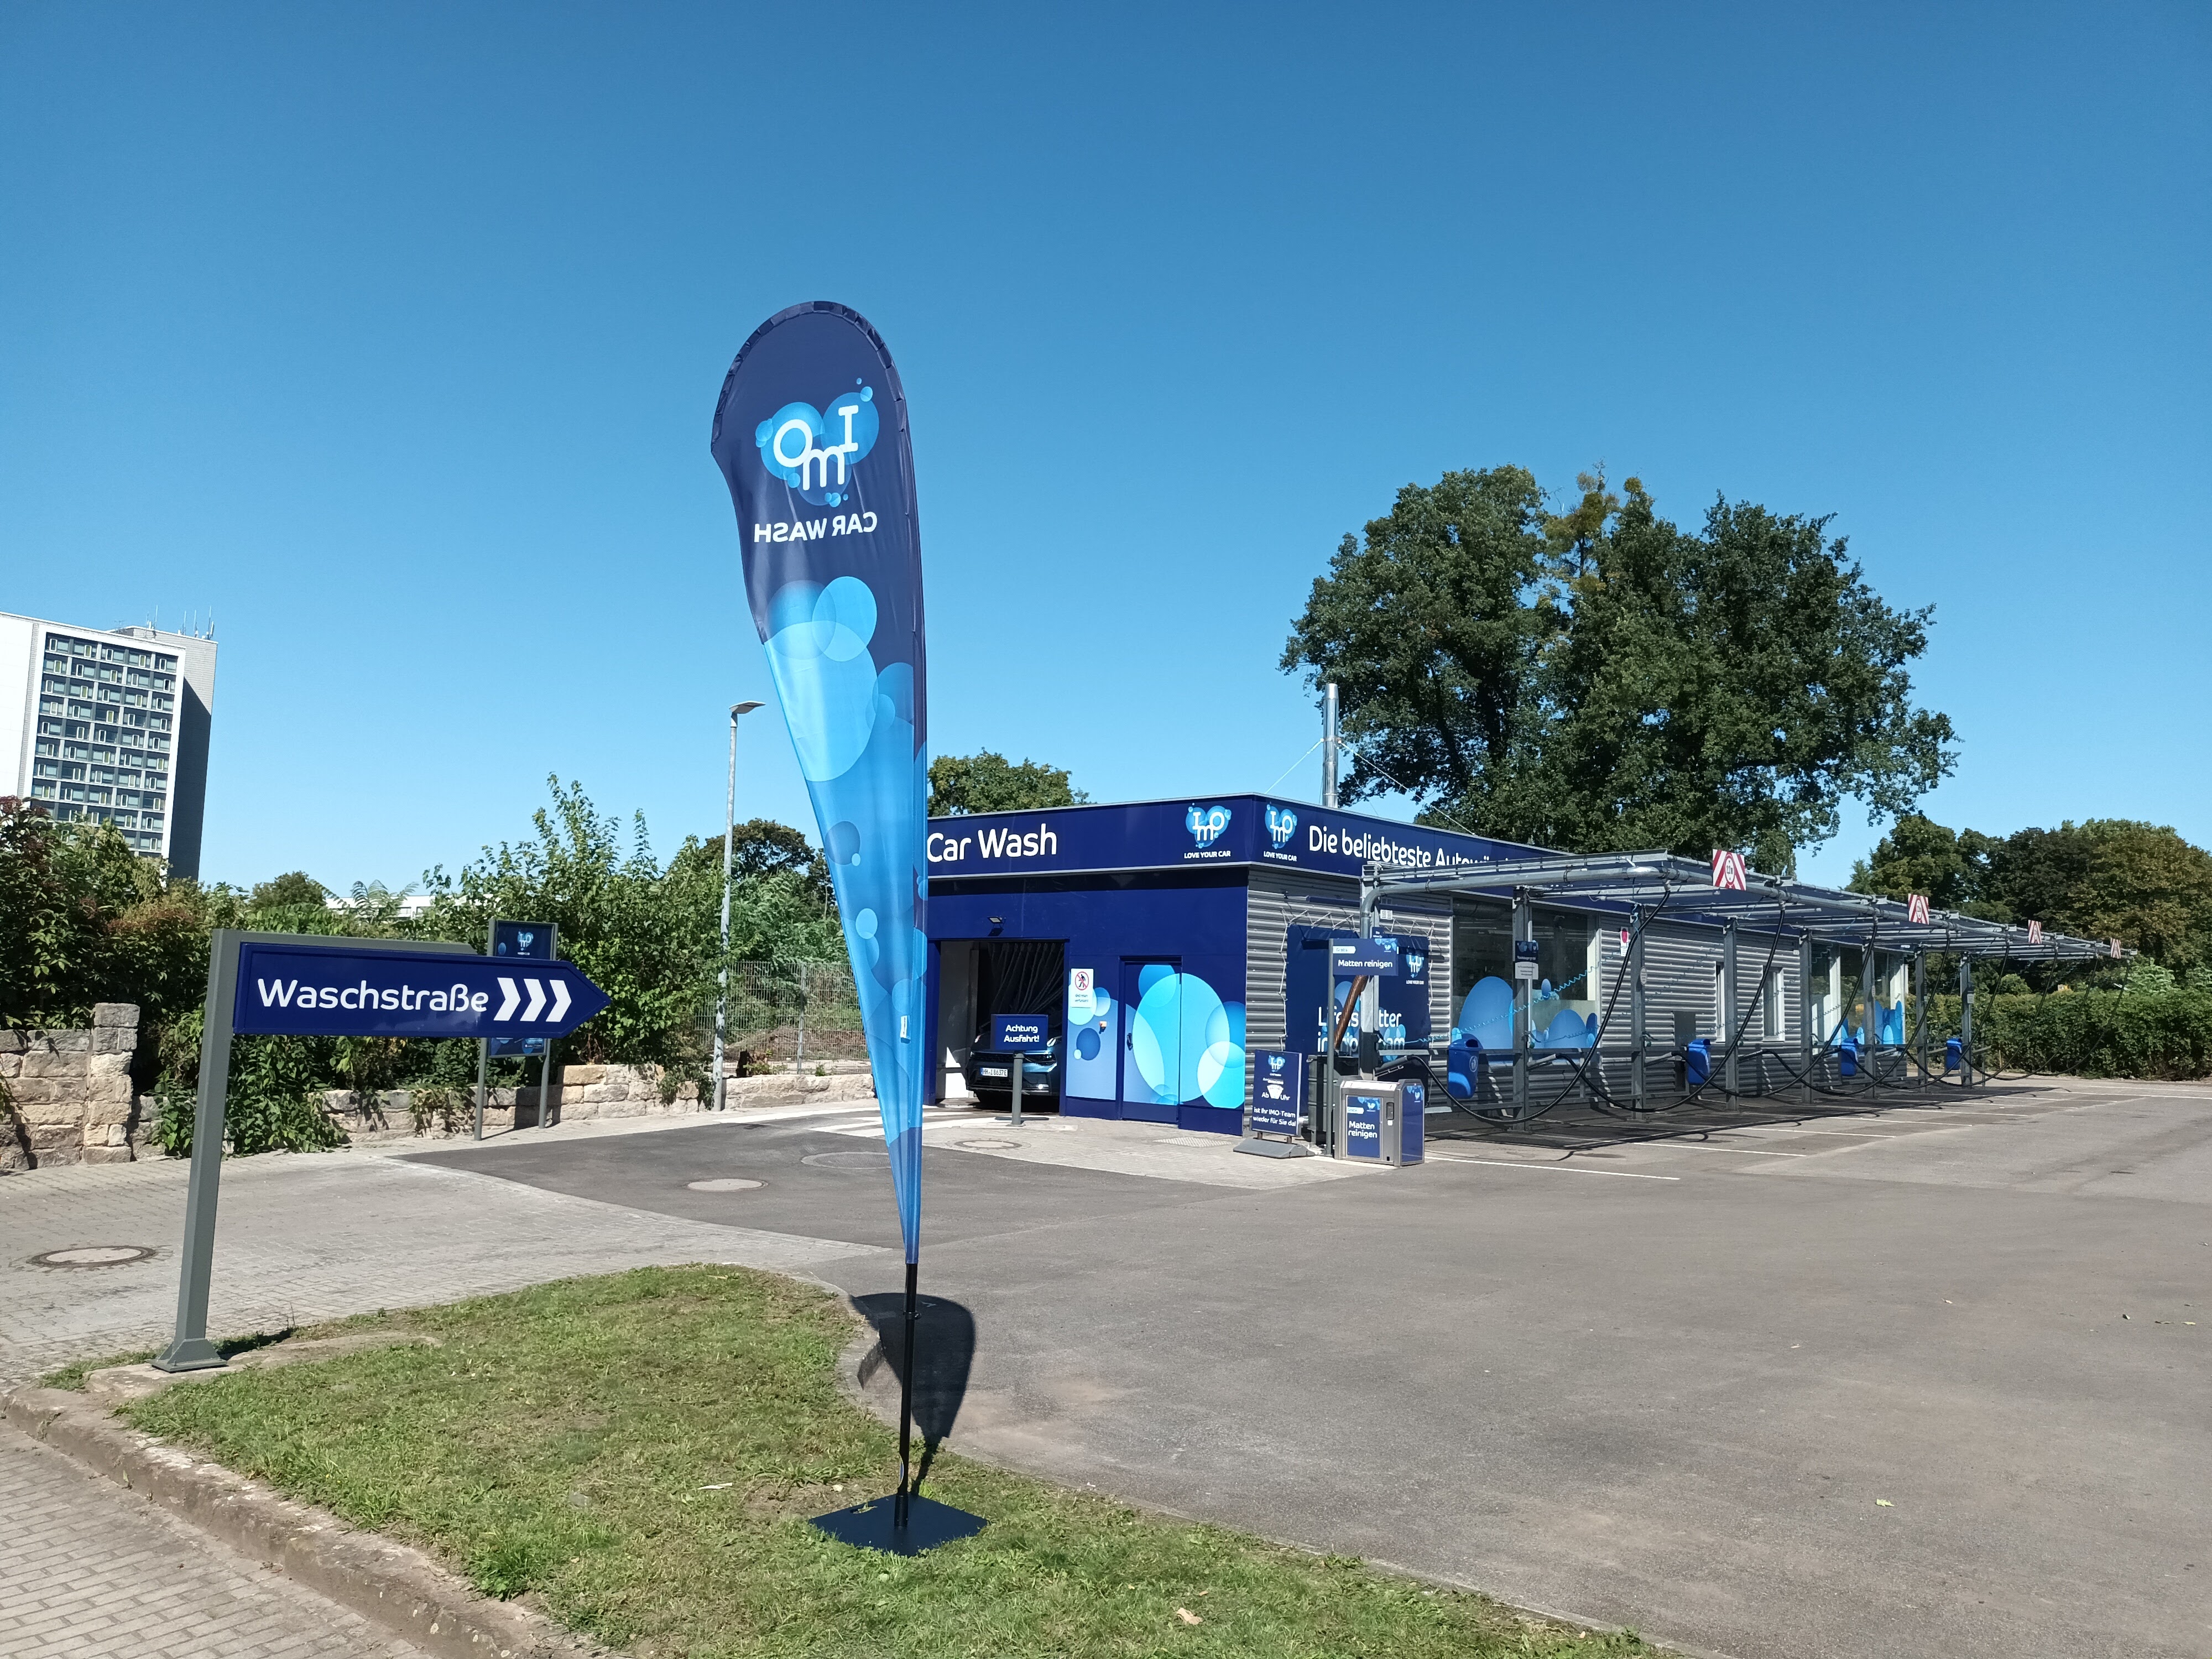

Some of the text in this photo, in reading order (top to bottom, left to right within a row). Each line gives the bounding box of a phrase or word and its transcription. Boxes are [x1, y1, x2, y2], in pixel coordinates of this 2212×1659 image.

[927, 823, 1057, 863] Car Wash
[1308, 825, 1338, 854] Die
[1342, 828, 1431, 868] beliebteste
[1275, 852, 1288, 860] YOUR
[1364, 959, 1393, 969] reinigen
[257, 978, 489, 1013] Waschstraße
[1005, 1025, 1039, 1033] Achtung
[1349, 1120, 1375, 1130] Matten
[1348, 1129, 1378, 1139] reinigen
